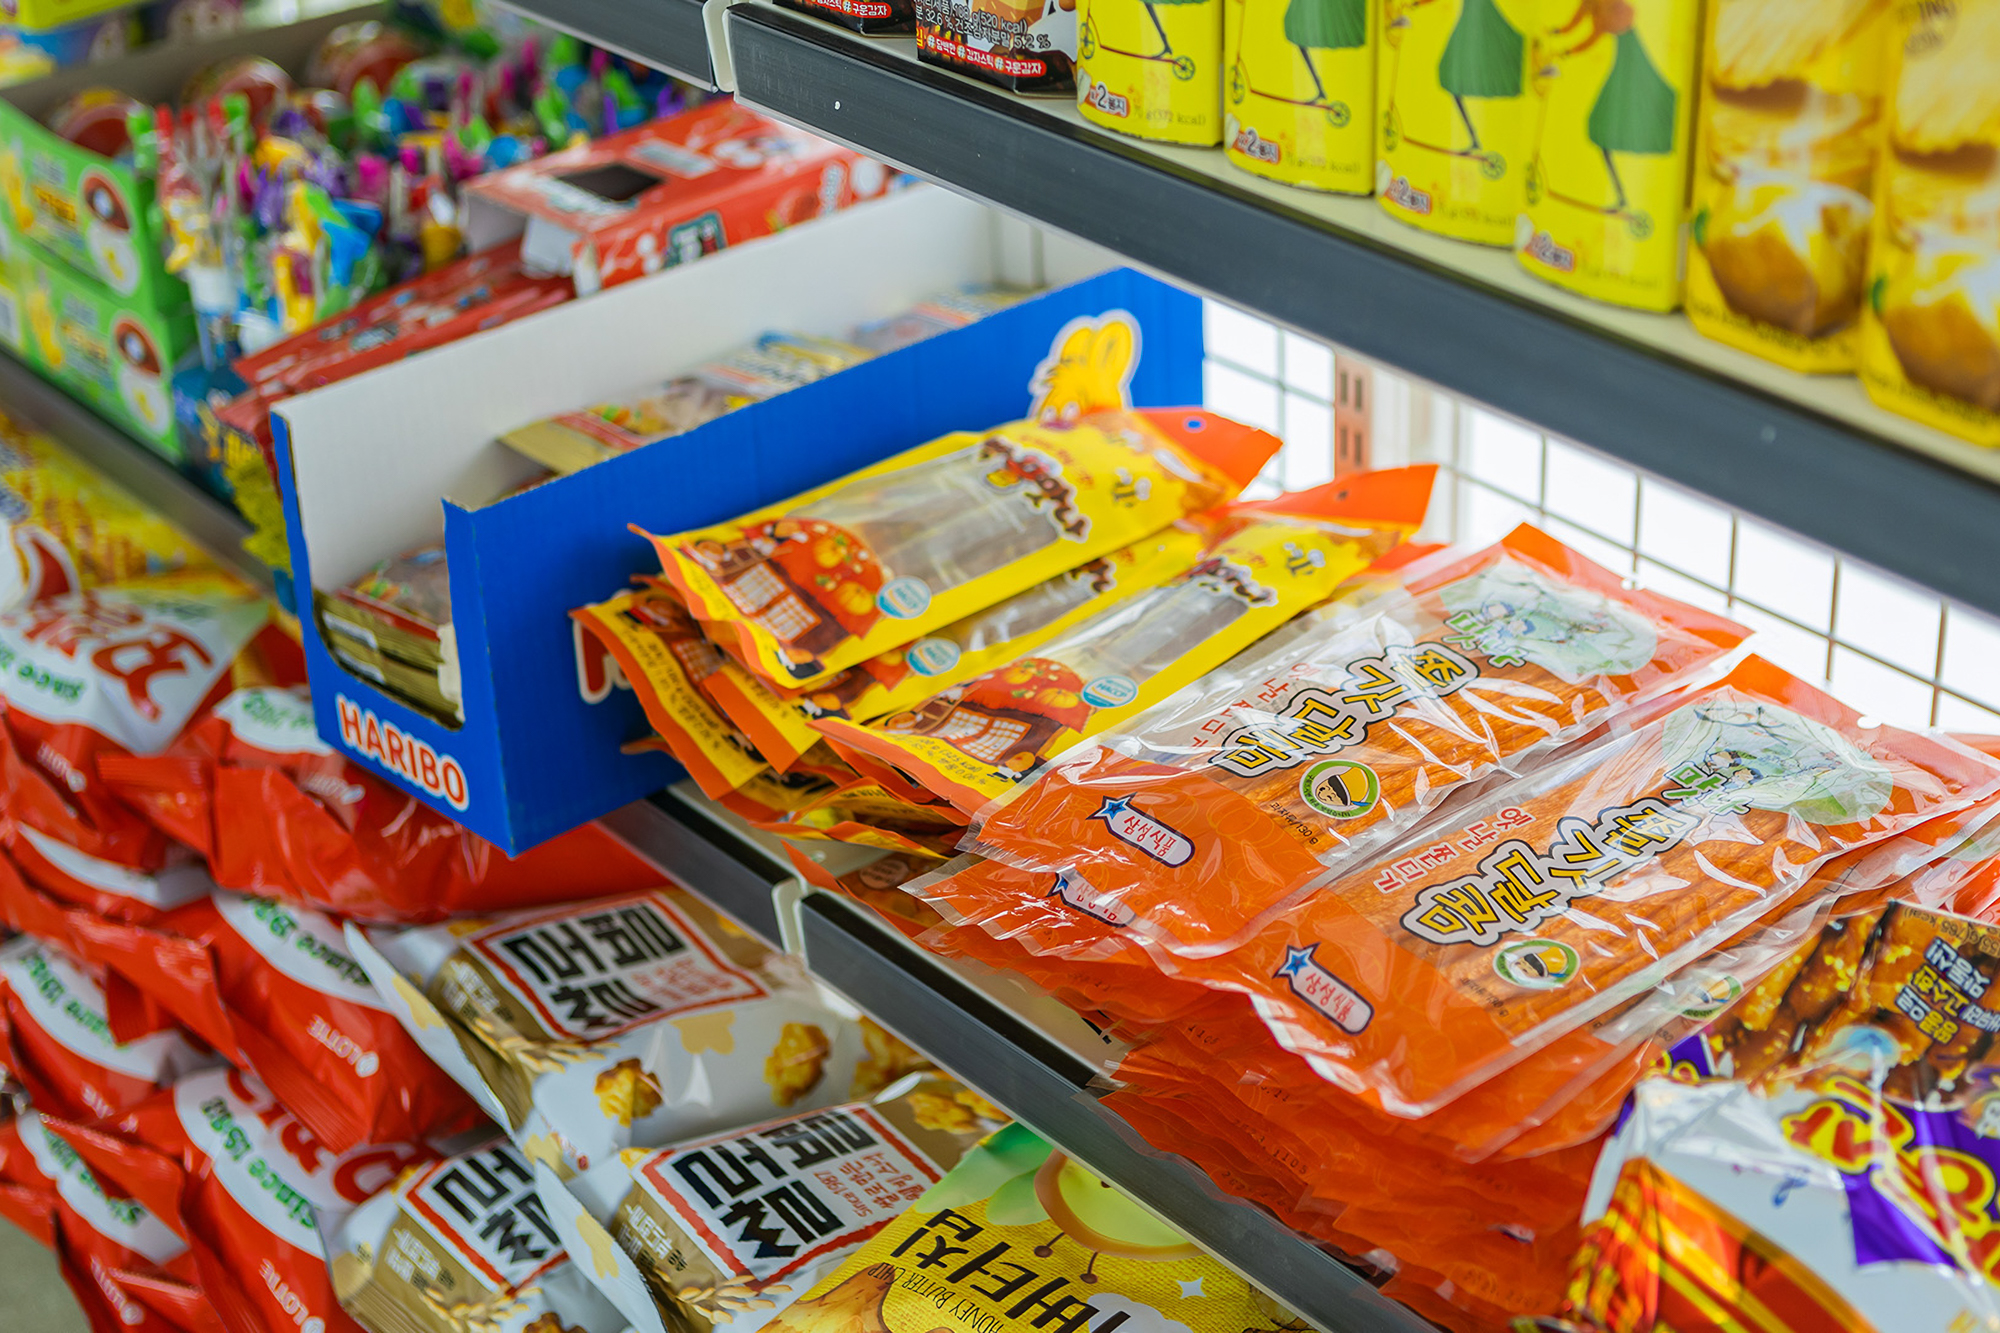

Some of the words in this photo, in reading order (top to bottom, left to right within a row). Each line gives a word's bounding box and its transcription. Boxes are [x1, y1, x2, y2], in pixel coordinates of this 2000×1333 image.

[1013, 33, 1034, 49] 5.2
[1036, 33, 1051, 49] %
[337, 697, 468, 808] HARIBO
[1123, 815, 1177, 858] 삼성식품
[1464, 807, 1532, 850] 옛날
[1375, 845, 1457, 893] 쫀디기
[1913, 965, 1969, 1017] 고소한
[1925, 938, 1991, 1000] 맛동산!
[1305, 972, 1356, 1024] 삼성식품
[306, 1013, 364, 1066] LOTTE
[671, 1110, 879, 1259] 쌀로별
[813, 1170, 842, 1197] 1987
[847, 1194, 874, 1219] Since
[257, 1257, 310, 1326] LOTTE
[866, 1261, 906, 1286] CHIP
[889, 1208, 1131, 1333] 버터칩
[900, 1272, 957, 1310] BUTTER
